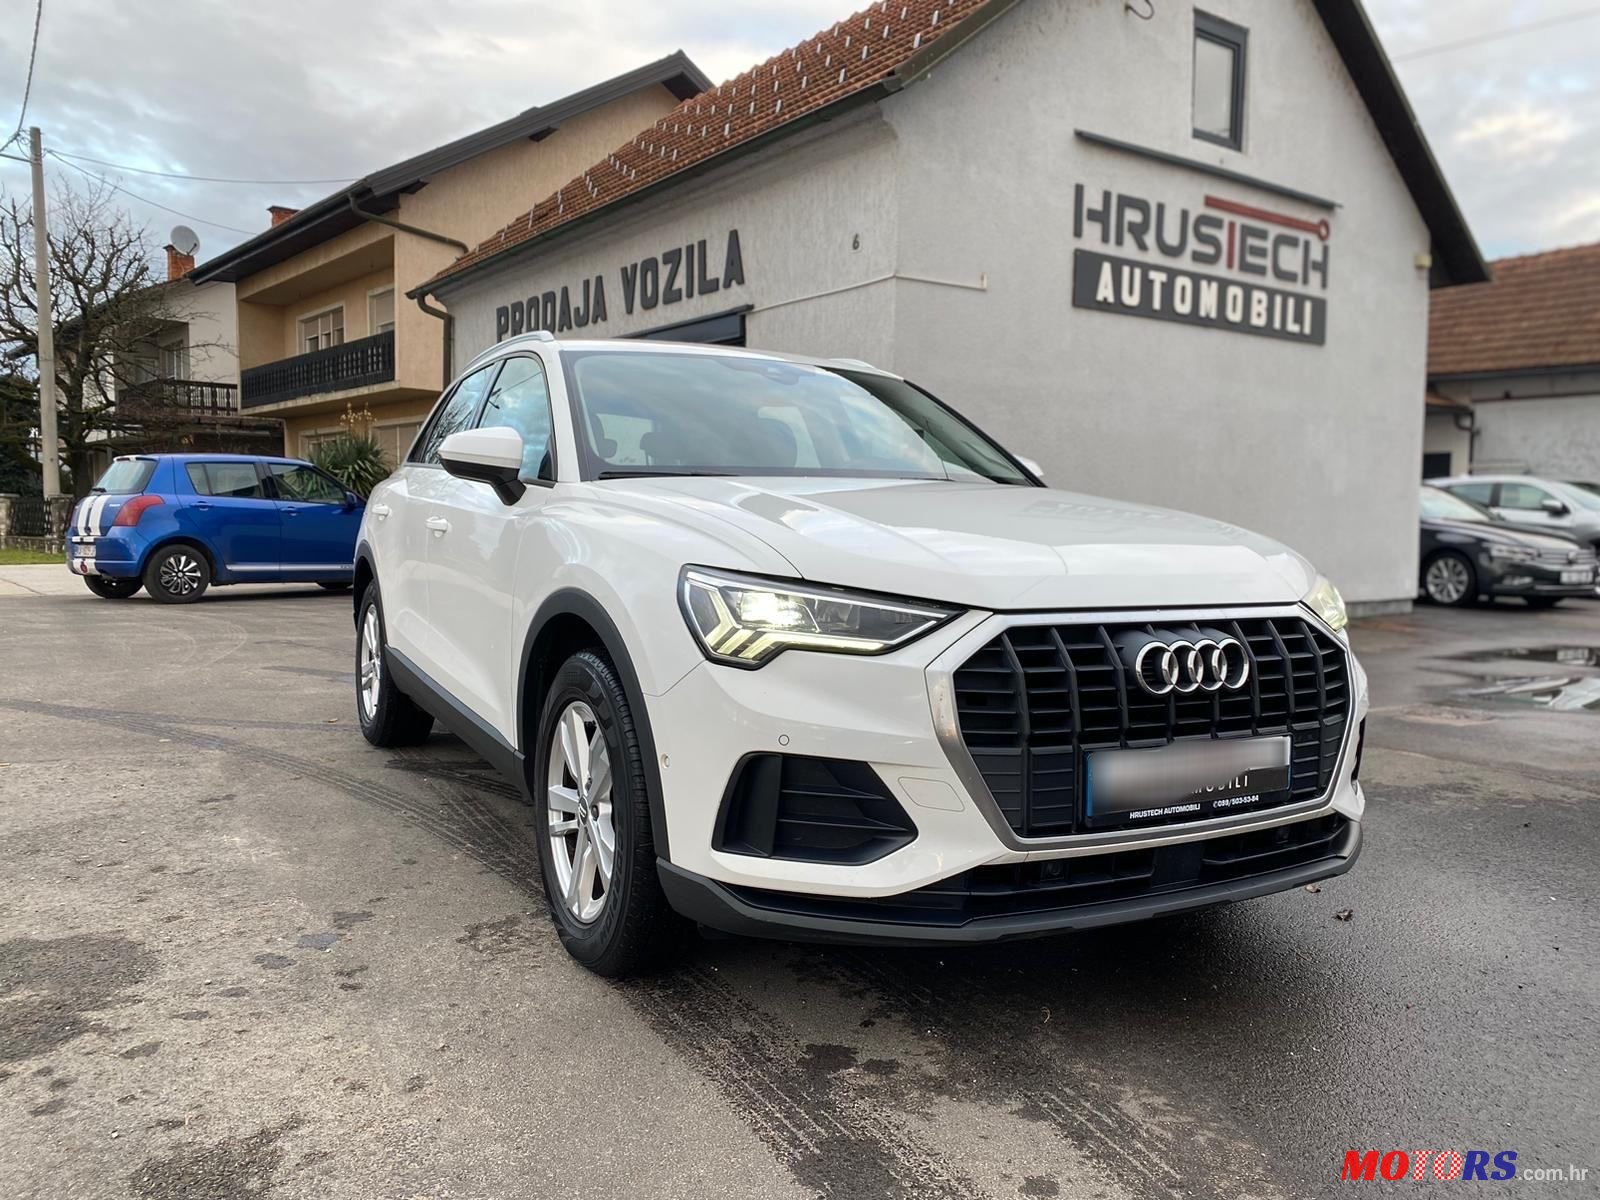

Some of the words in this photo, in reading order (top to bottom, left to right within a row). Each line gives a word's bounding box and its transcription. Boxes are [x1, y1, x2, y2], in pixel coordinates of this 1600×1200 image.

[852, 233, 860, 250] 6
[1073, 183, 1330, 290] HRUSTECH
[496, 275, 607, 343] PRODAJA
[620, 229, 744, 315] VOZILA
[1096, 261, 1312, 335] AUTOMOBILI
[1129, 807, 1163, 819] HRUSTECH
[1164, 803, 1201, 815] AUTOMOBILI
